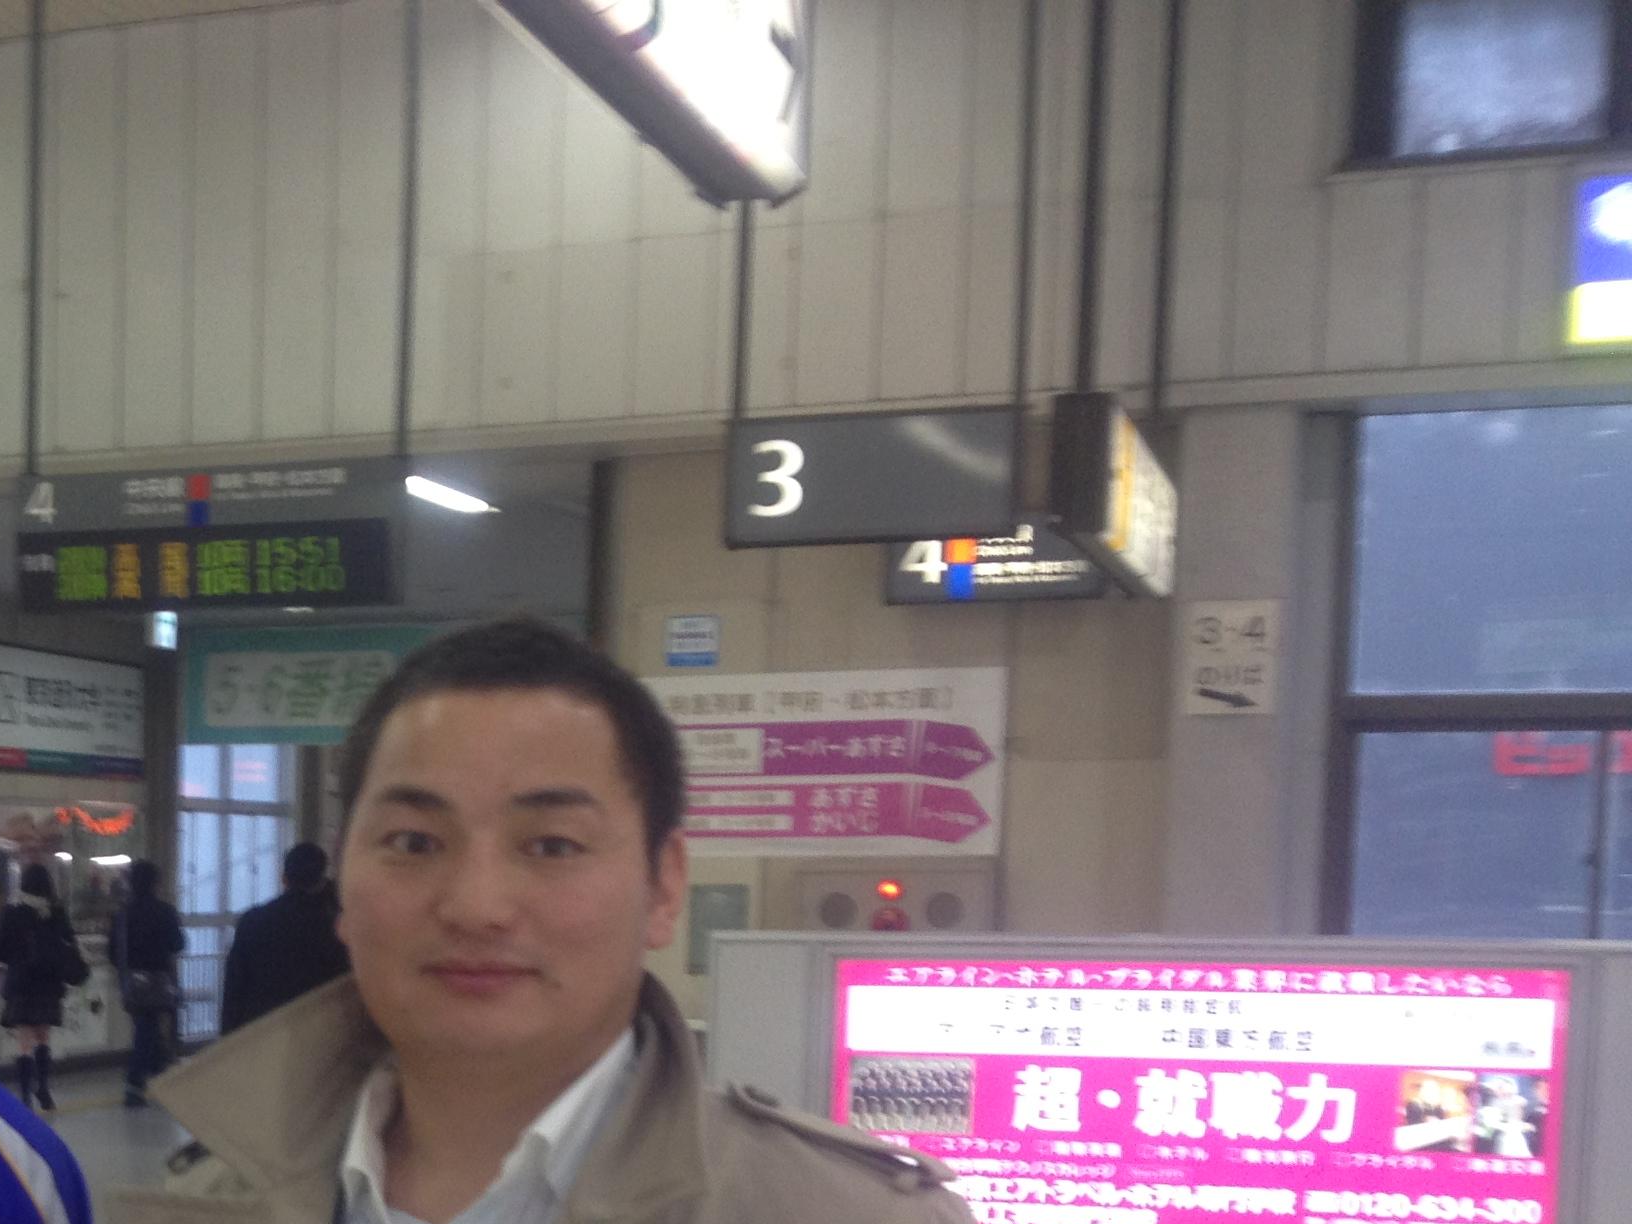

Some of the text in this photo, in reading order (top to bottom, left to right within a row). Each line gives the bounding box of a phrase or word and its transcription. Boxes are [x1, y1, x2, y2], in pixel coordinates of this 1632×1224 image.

[23, 481, 59, 523] 4
[747, 438, 806, 518] 3
[898, 540, 948, 584] 4
[1011, 1062, 1358, 1145] 超・就職力
